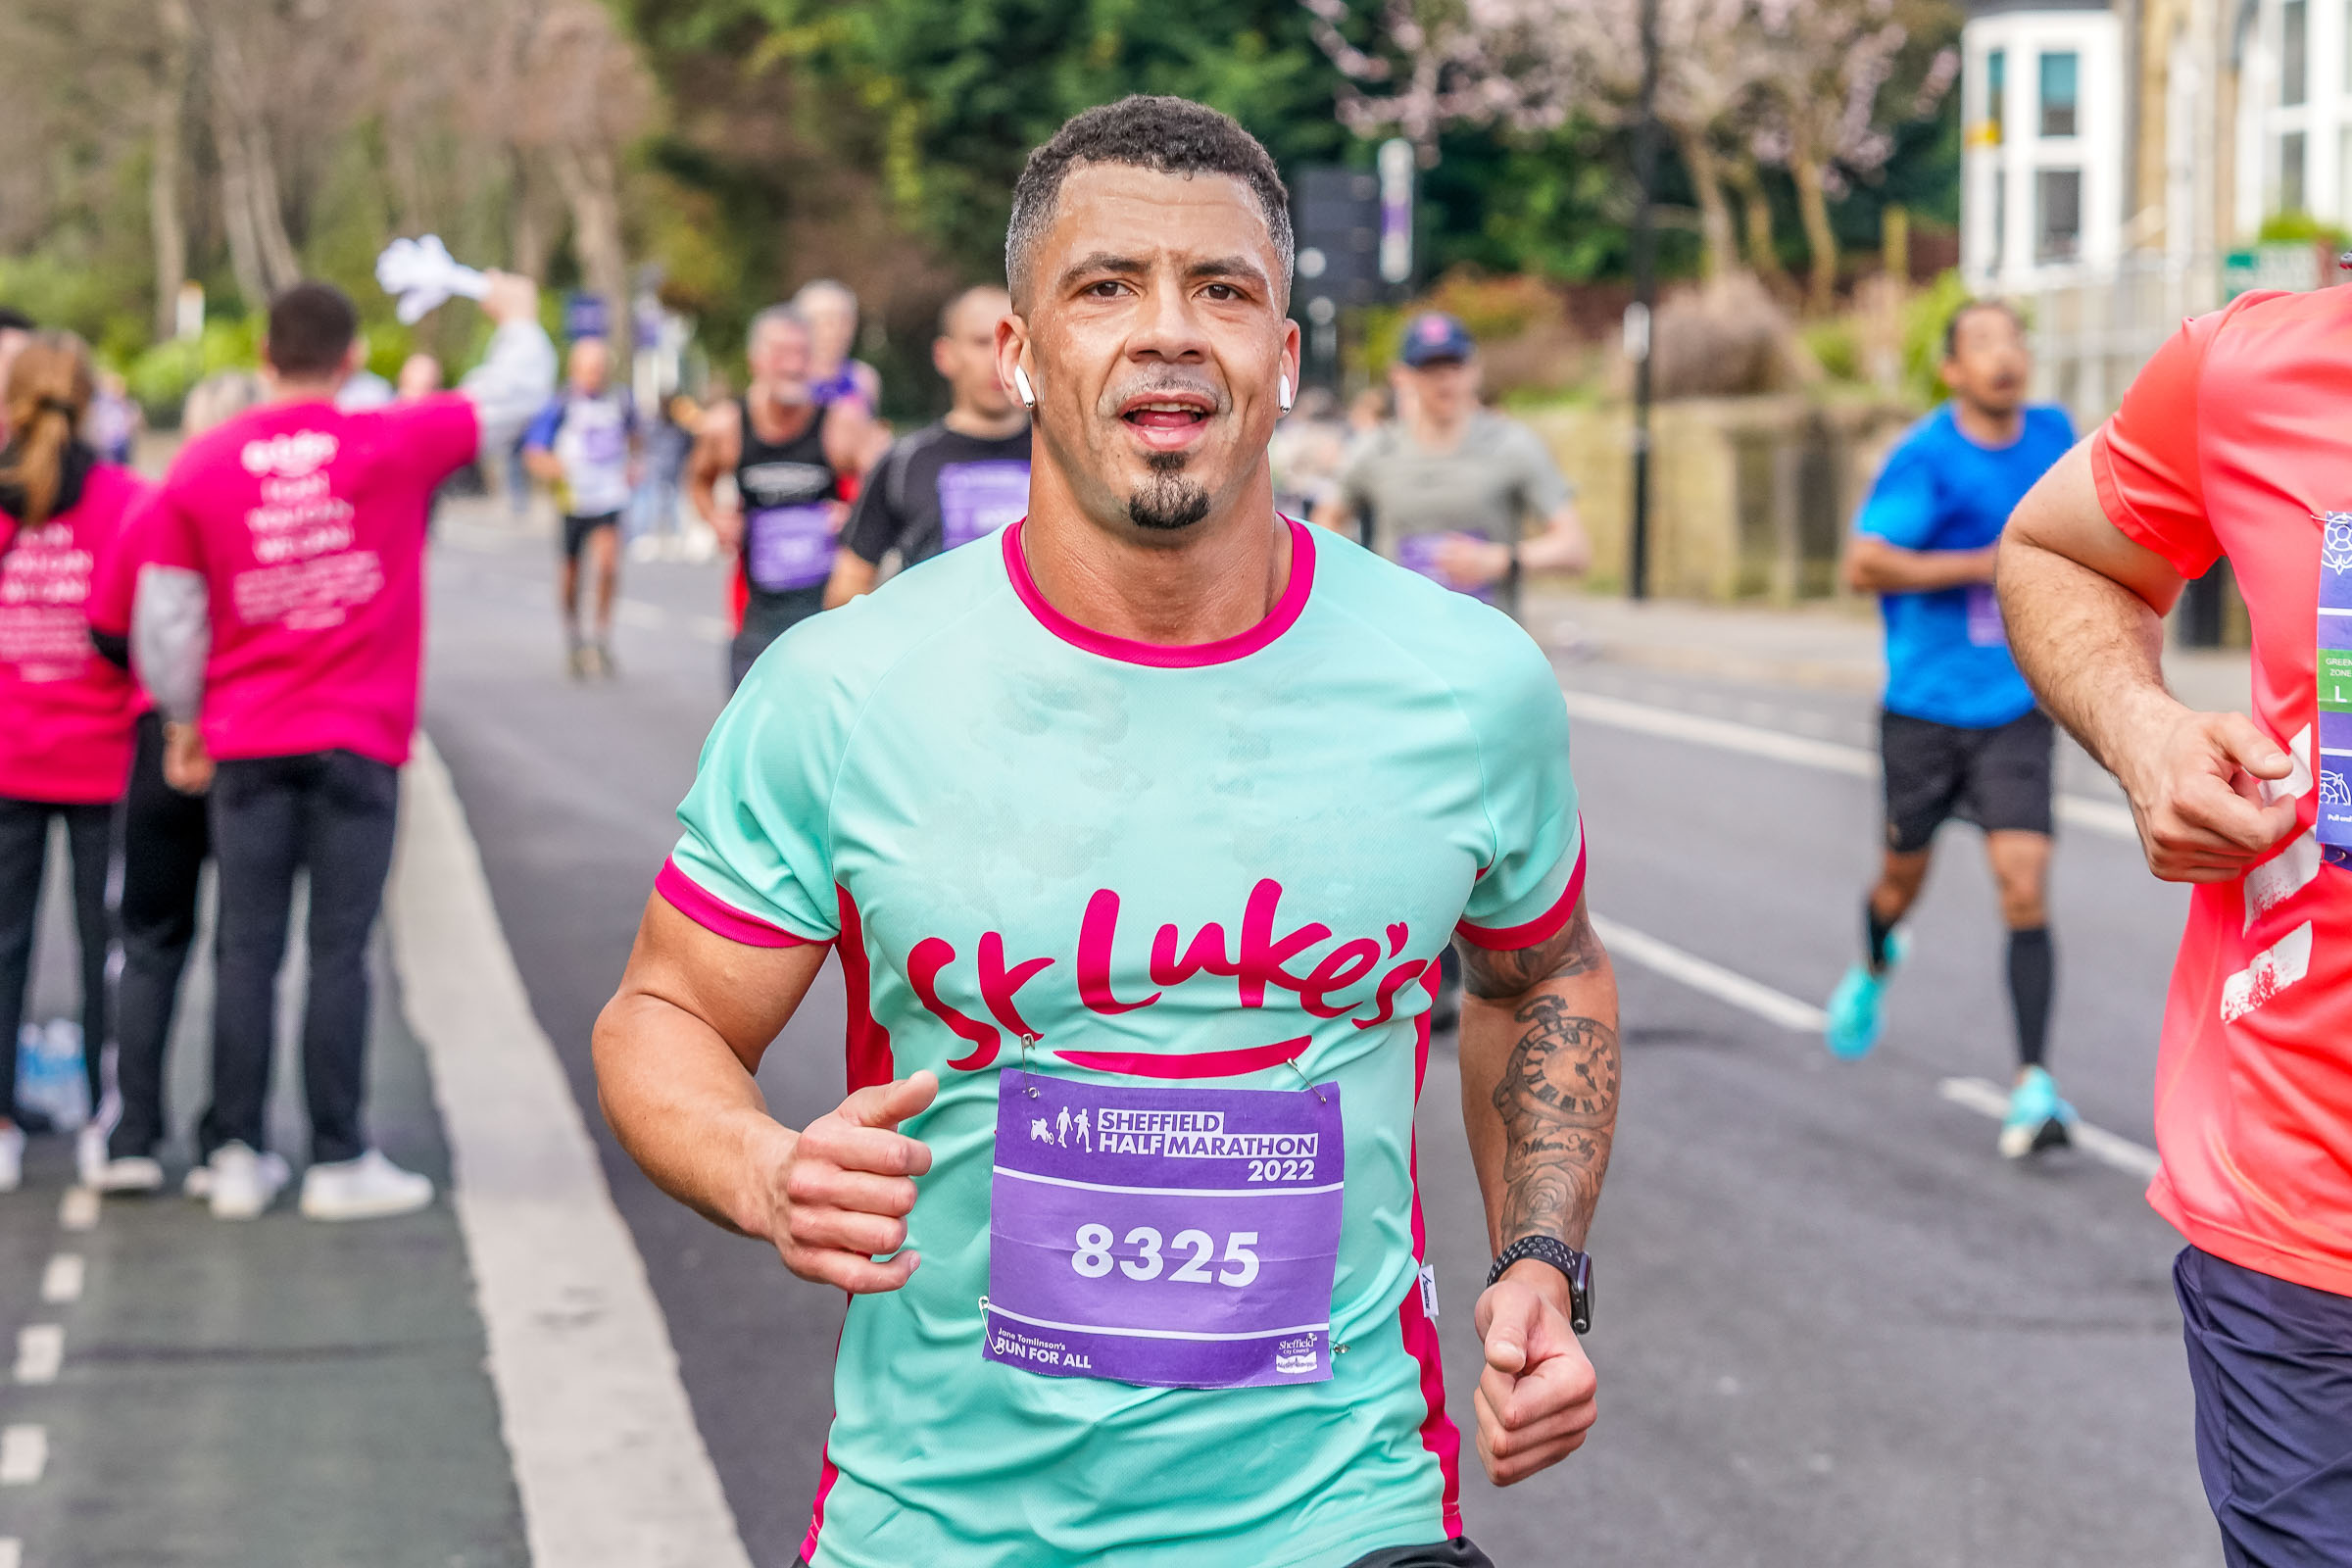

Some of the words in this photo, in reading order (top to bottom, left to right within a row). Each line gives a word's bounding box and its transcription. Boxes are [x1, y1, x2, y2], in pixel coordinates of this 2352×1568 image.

[2329, 668, 2352, 677] ZONE
[2334, 685, 2347, 703] L
[907, 931, 1055, 1071] St
[1077, 878, 1428, 1030] Luke's
[1101, 1111, 1220, 1132] SHEFFIELD
[1099, 1133, 1164, 1155] HALF
[1167, 1137, 1316, 1156] MARATHON
[1247, 1159, 1315, 1182] 2022
[1071, 1223, 1260, 1288] 8325
[998, 1327, 1016, 1340] Jane
[1017, 1334, 1066, 1351] Tomlinson's
[1279, 1338, 1314, 1349] Sheffield
[997, 1337, 1026, 1358] RUN
[1029, 1347, 1059, 1365] FOR
[1063, 1352, 1092, 1369] ALL
